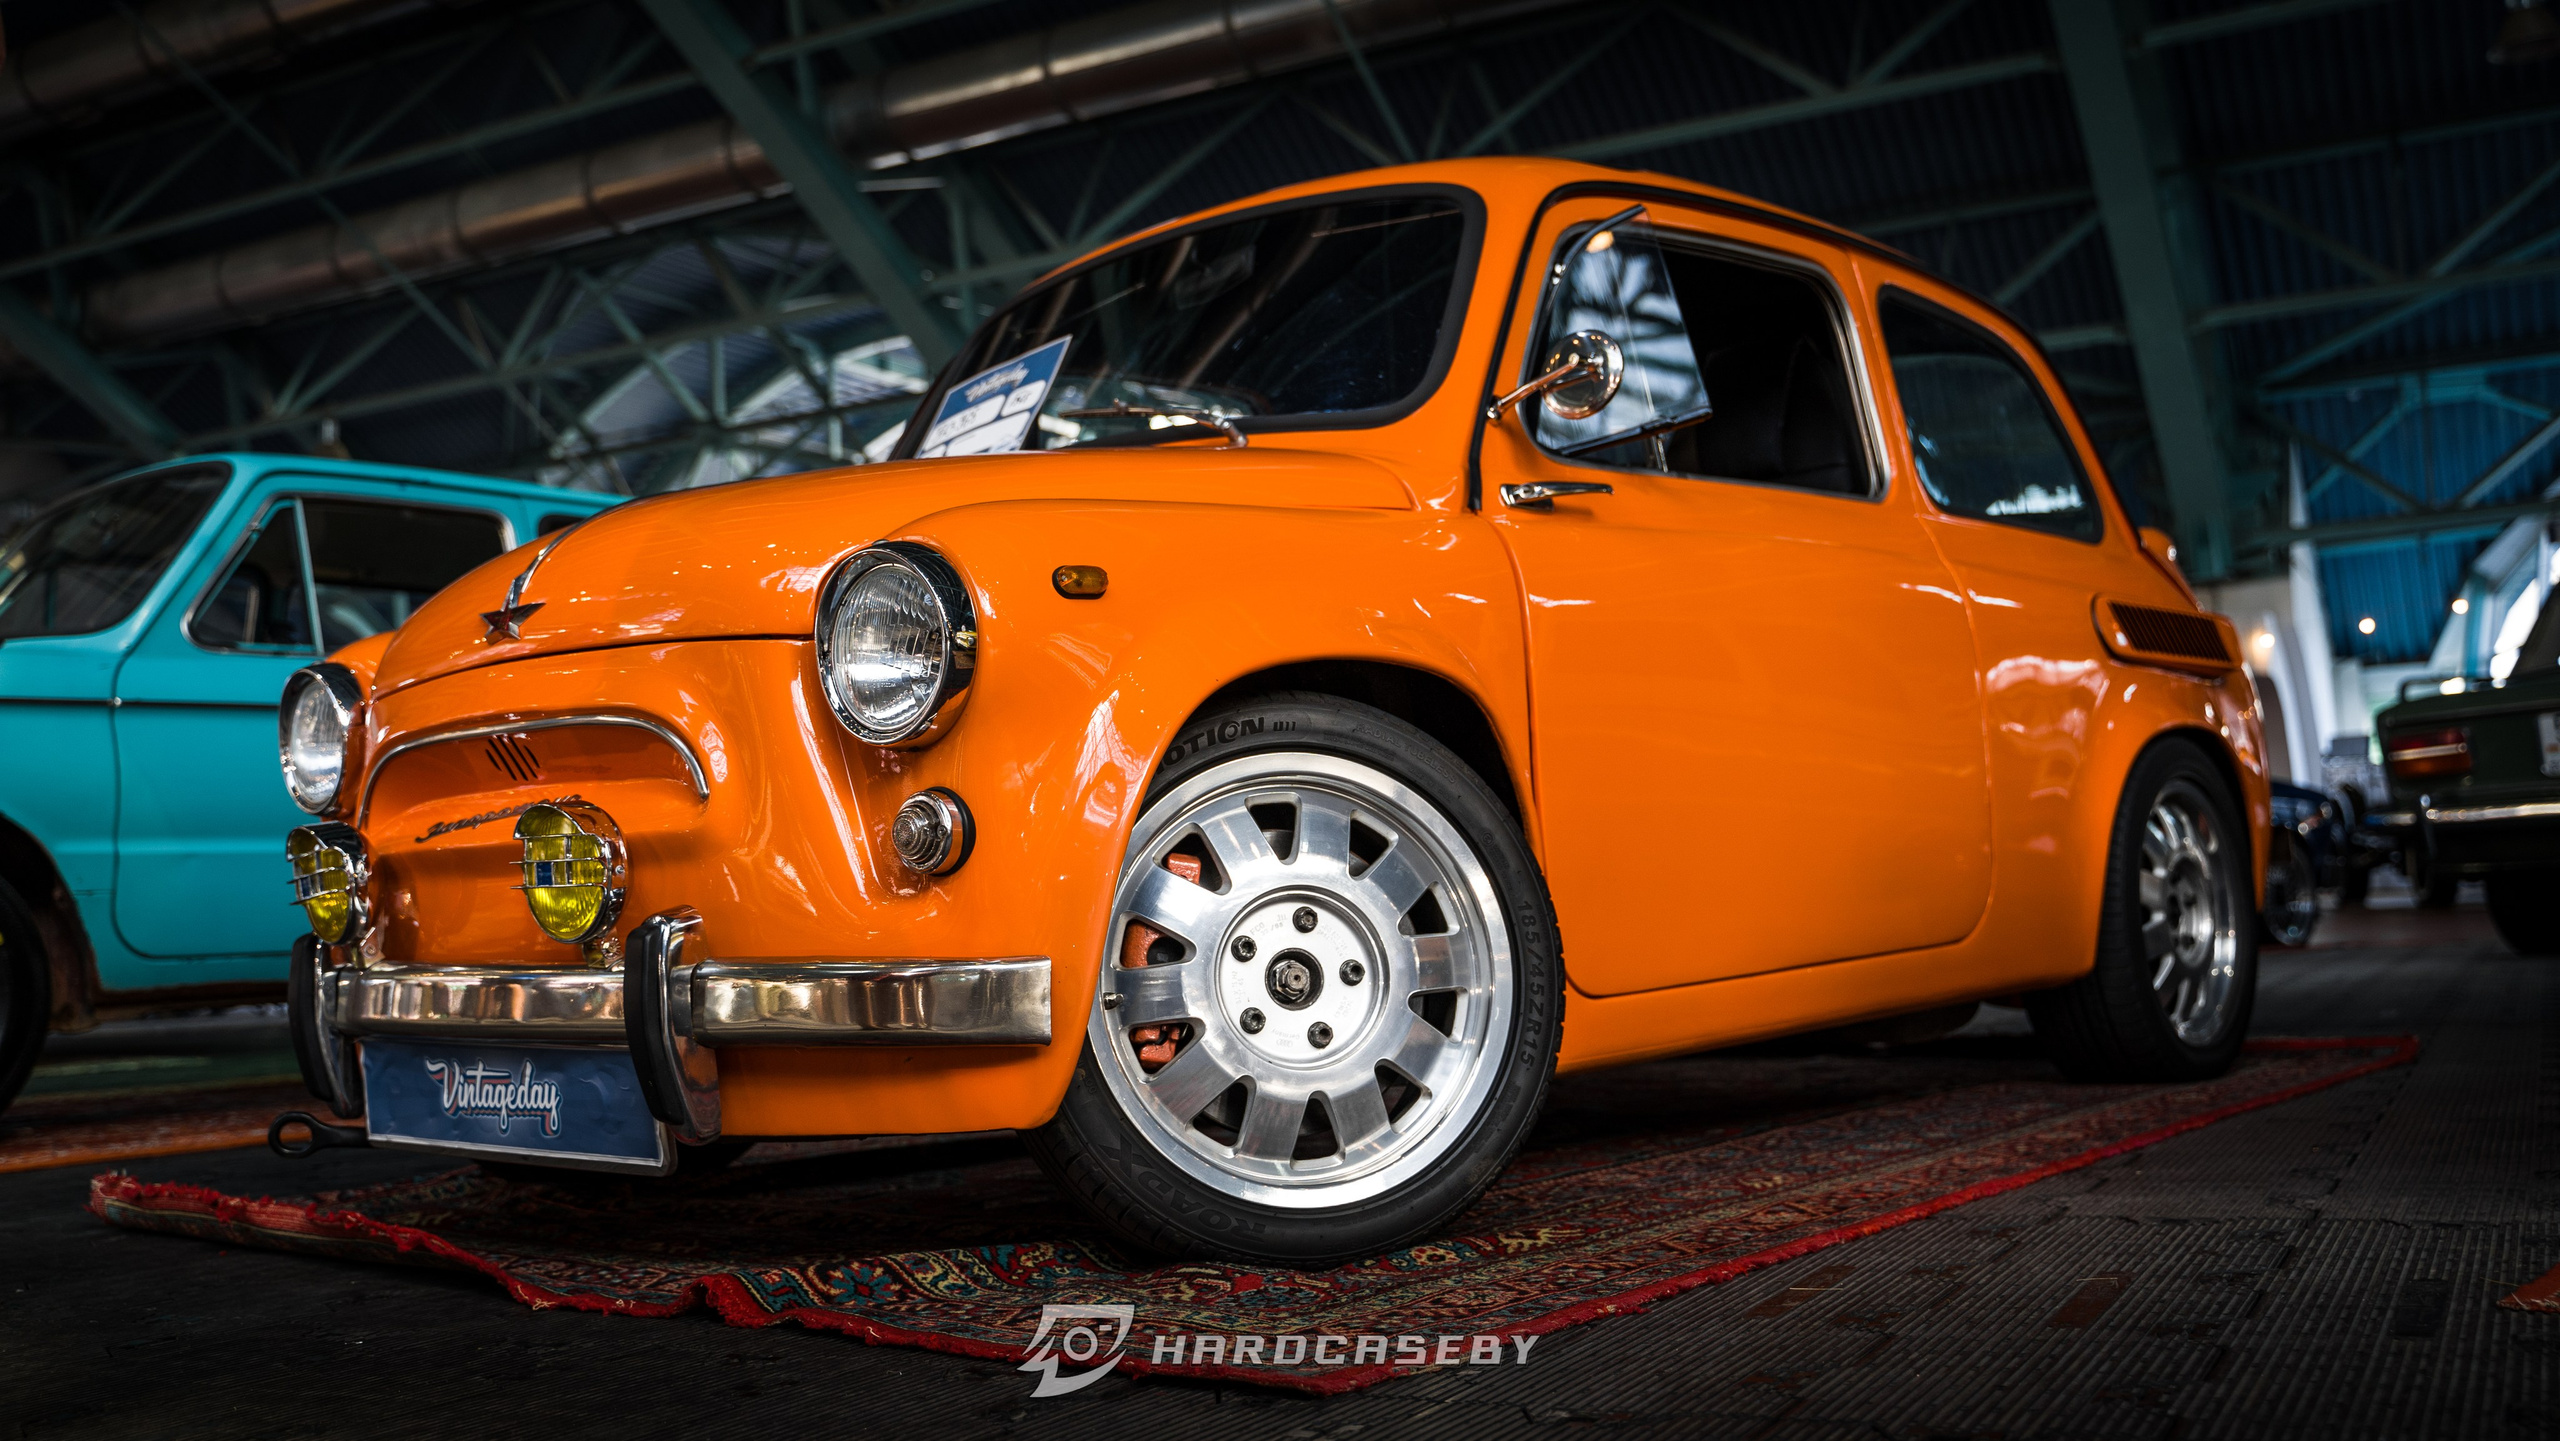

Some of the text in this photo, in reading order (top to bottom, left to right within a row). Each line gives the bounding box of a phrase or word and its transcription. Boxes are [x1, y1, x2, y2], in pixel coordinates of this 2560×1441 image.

[1155, 717, 1265, 775] OTION
[1355, 722, 1400, 748] RADIAL
[1403, 742, 1455, 783] TUBELESS
[1517, 900, 1545, 1068] 185/45ZR15
[425, 1056, 561, 1136] Vintageday
[1098, 1132, 1268, 1243] ROADX
